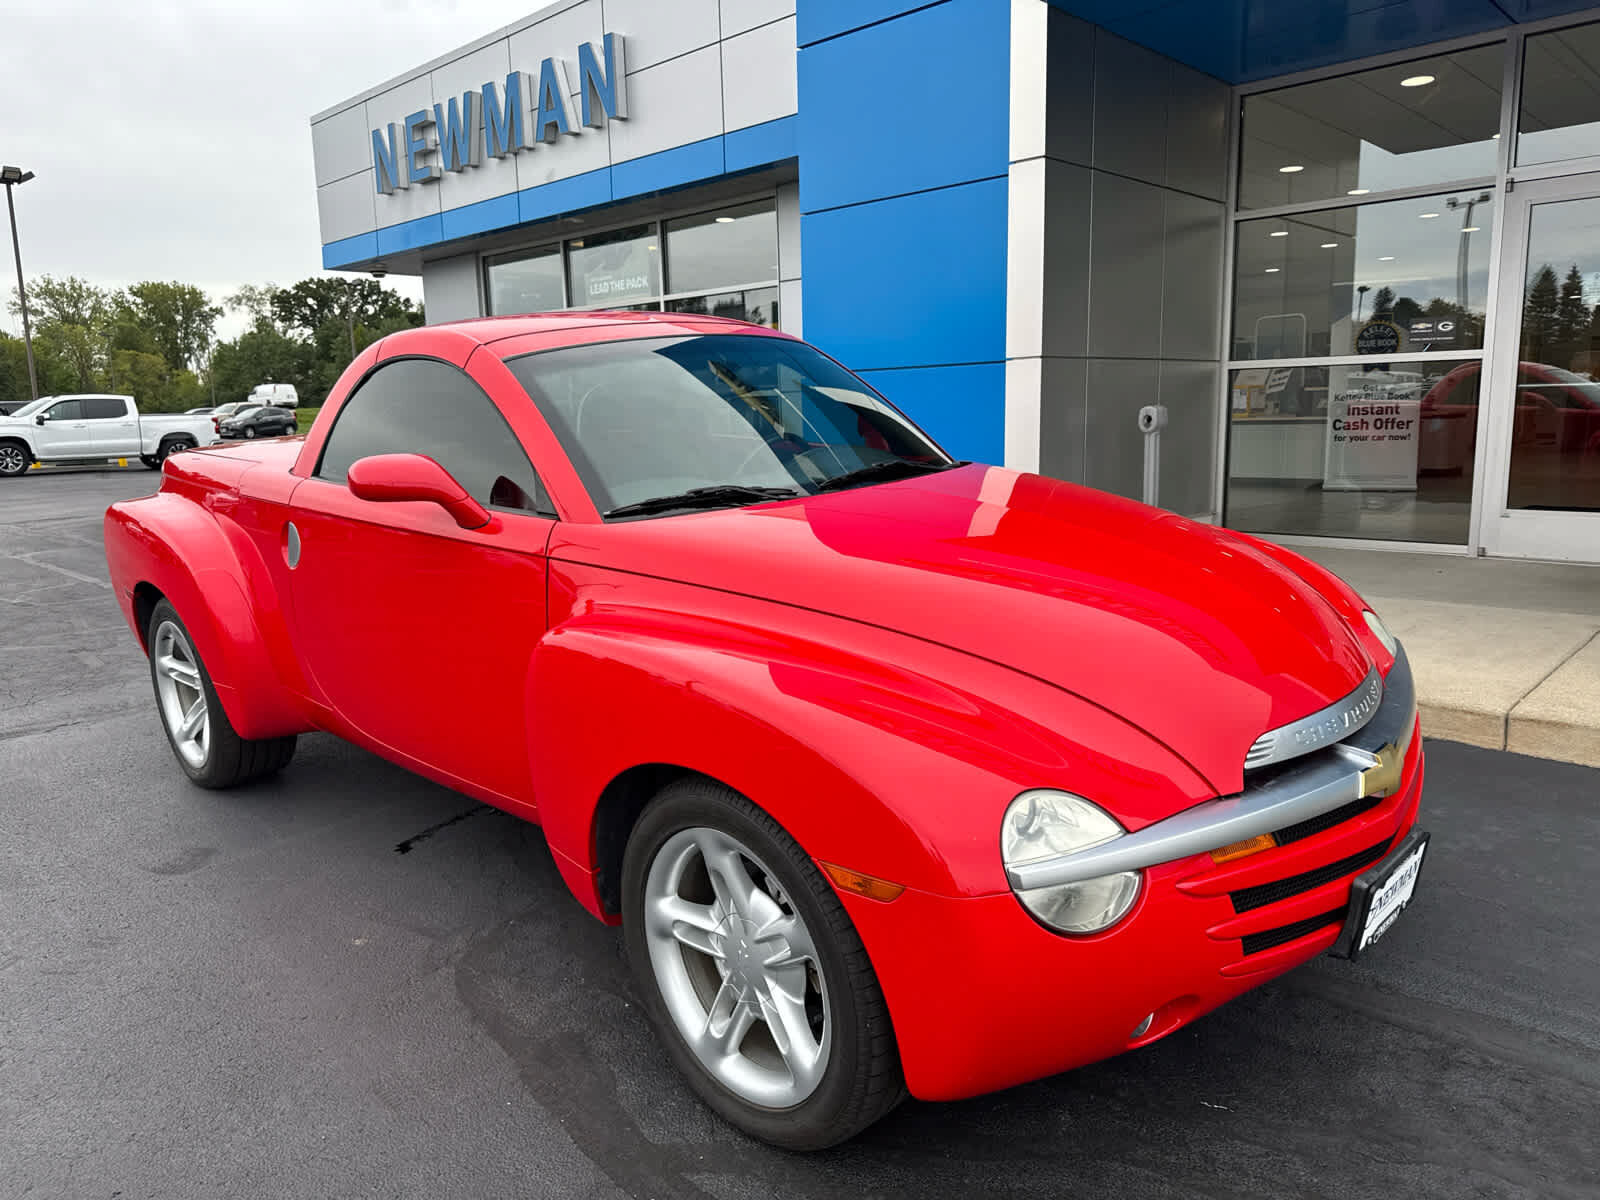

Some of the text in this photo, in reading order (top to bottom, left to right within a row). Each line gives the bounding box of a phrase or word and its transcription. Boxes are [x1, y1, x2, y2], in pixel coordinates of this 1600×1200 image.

[372, 32, 628, 195] NEWMAN
[590, 281, 609, 295] LEAD
[609, 279, 625, 291] THE
[626, 276, 649, 290] PACK
[1363, 384, 1378, 392] Get
[1347, 403, 1400, 416] Instant
[1332, 417, 1414, 431] Cash Offer
[1334, 433, 1347, 442] for
[1349, 435, 1369, 443] your
[1388, 433, 1411, 441] now!
